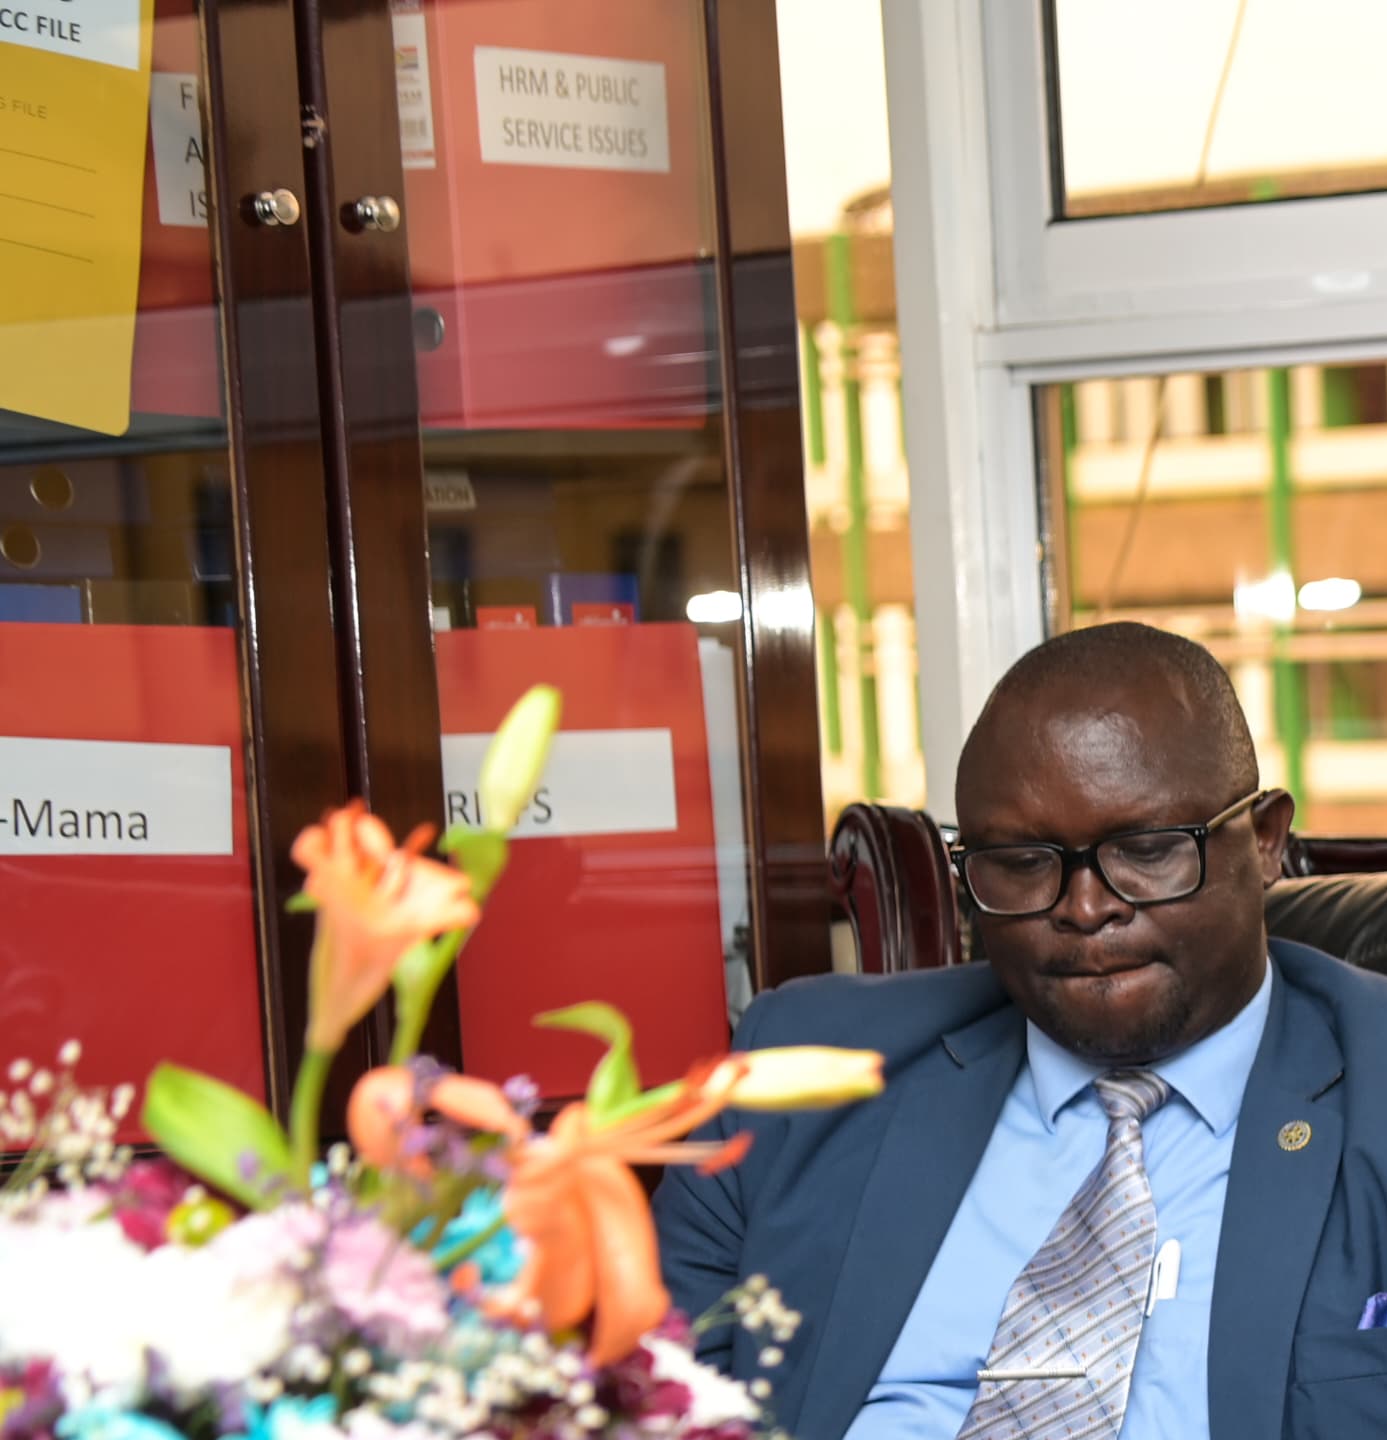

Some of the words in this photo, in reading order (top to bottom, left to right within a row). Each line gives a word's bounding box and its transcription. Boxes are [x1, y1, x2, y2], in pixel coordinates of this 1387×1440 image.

[36, 15, 82, 42] FILE
[499, 65, 549, 97] HRM
[554, 71, 570, 99] &
[575, 73, 640, 106] PUBLIC
[11, 99, 47, 120] FILE
[502, 117, 584, 153] SERVICE
[588, 124, 649, 158] ISSUES
